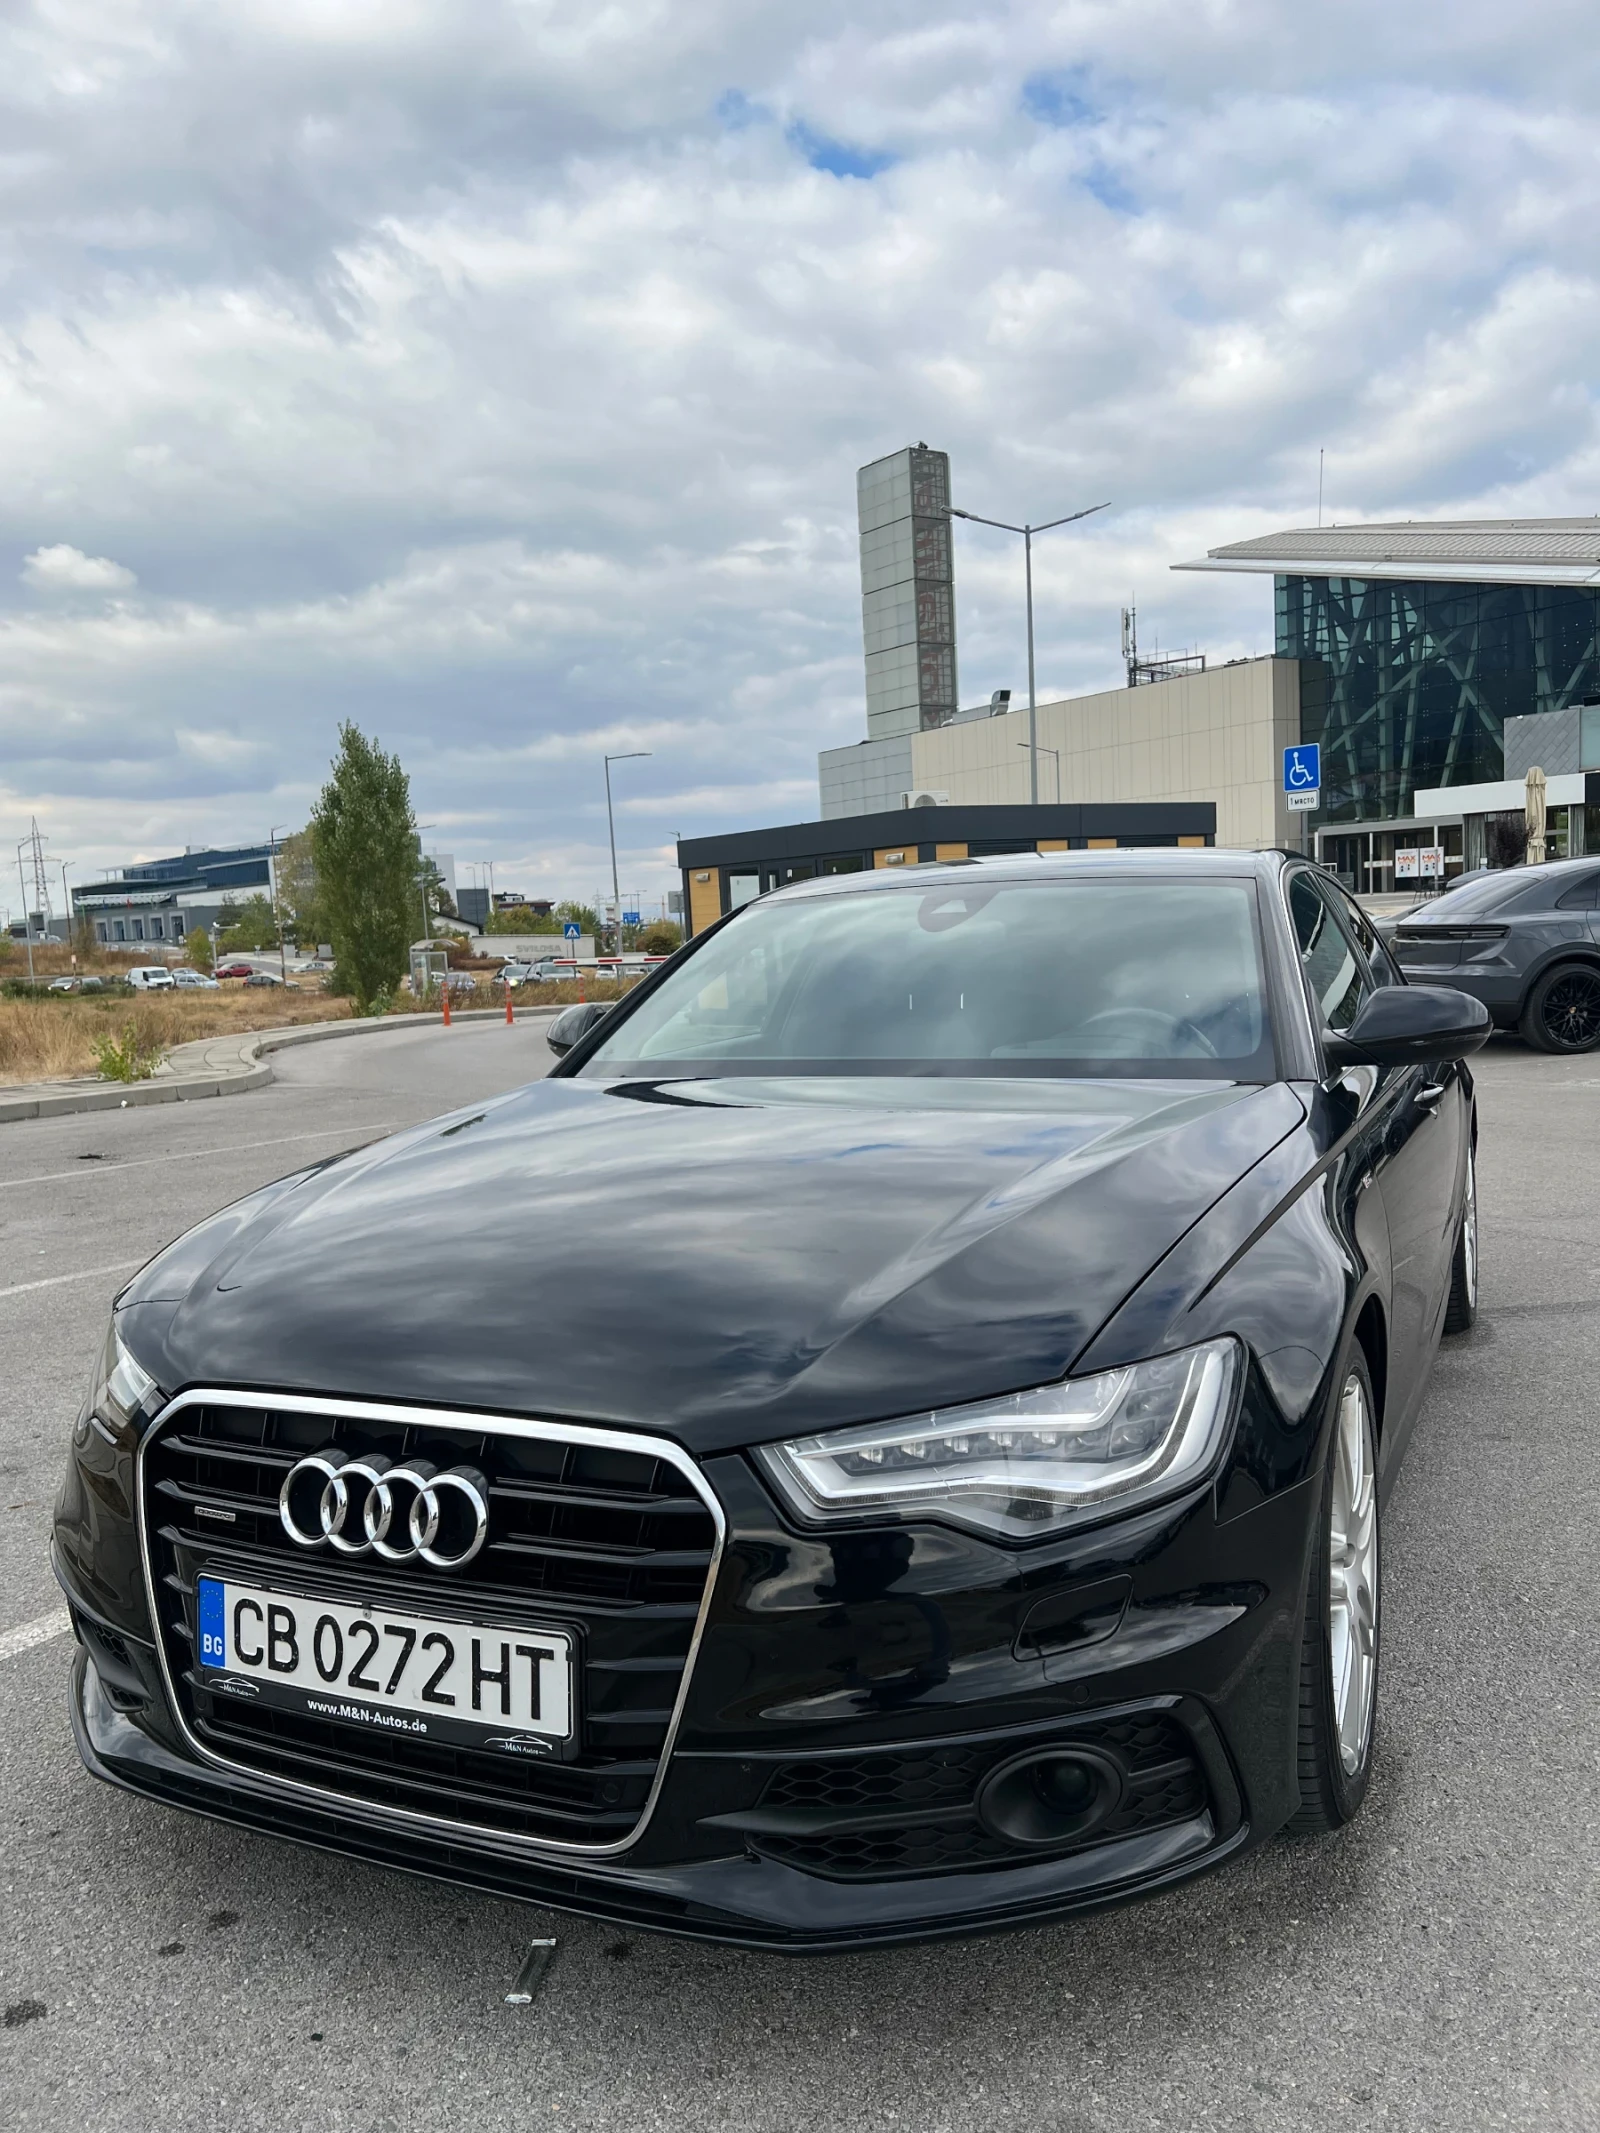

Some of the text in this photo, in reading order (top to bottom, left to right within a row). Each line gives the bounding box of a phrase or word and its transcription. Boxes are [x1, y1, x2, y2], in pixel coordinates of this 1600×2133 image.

[516, 944, 561, 952] SVILOSA
[203, 1633, 223, 1656] BG
[233, 1598, 554, 1720] CB 0272 HT
[307, 1700, 428, 1733] www.M&N-Autos.de
[504, 1741, 539, 1755] M&N Autos
